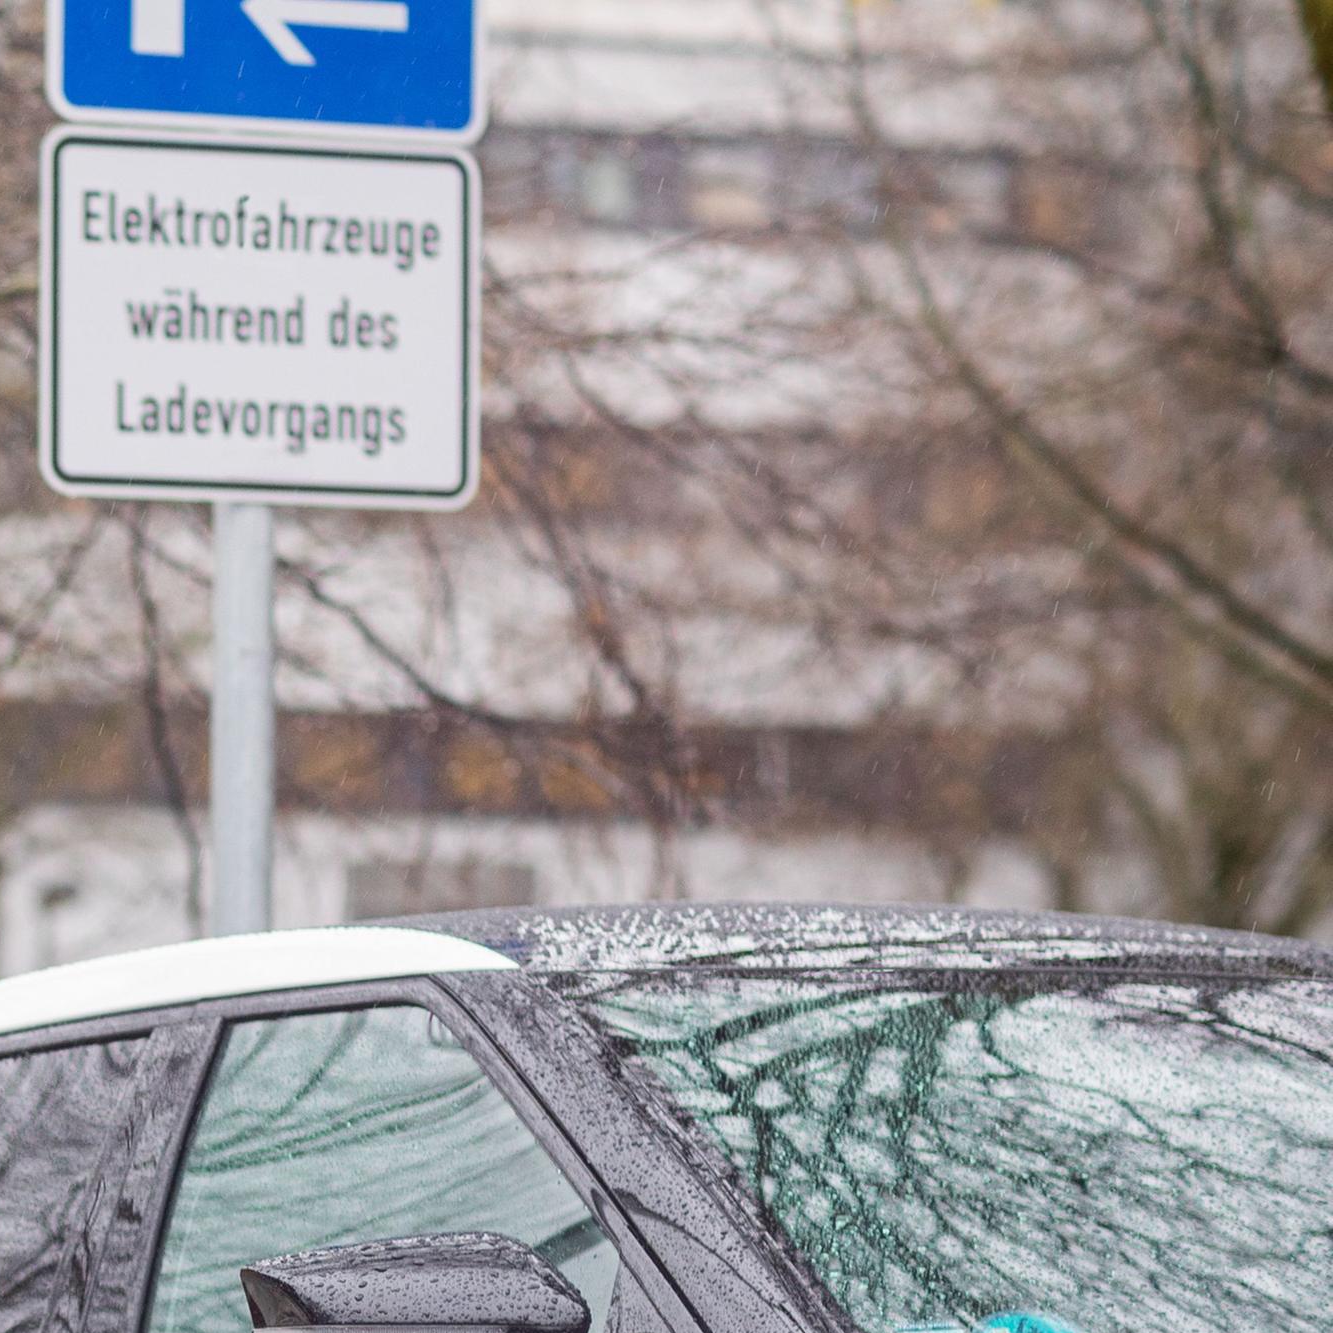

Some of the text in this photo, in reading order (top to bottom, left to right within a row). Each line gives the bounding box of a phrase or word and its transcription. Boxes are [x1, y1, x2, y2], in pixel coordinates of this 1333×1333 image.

[82, 189, 441, 271] Elektrofahrzeuge
[125, 288, 399, 350] während des
[114, 382, 406, 456] Ladevorgangs
